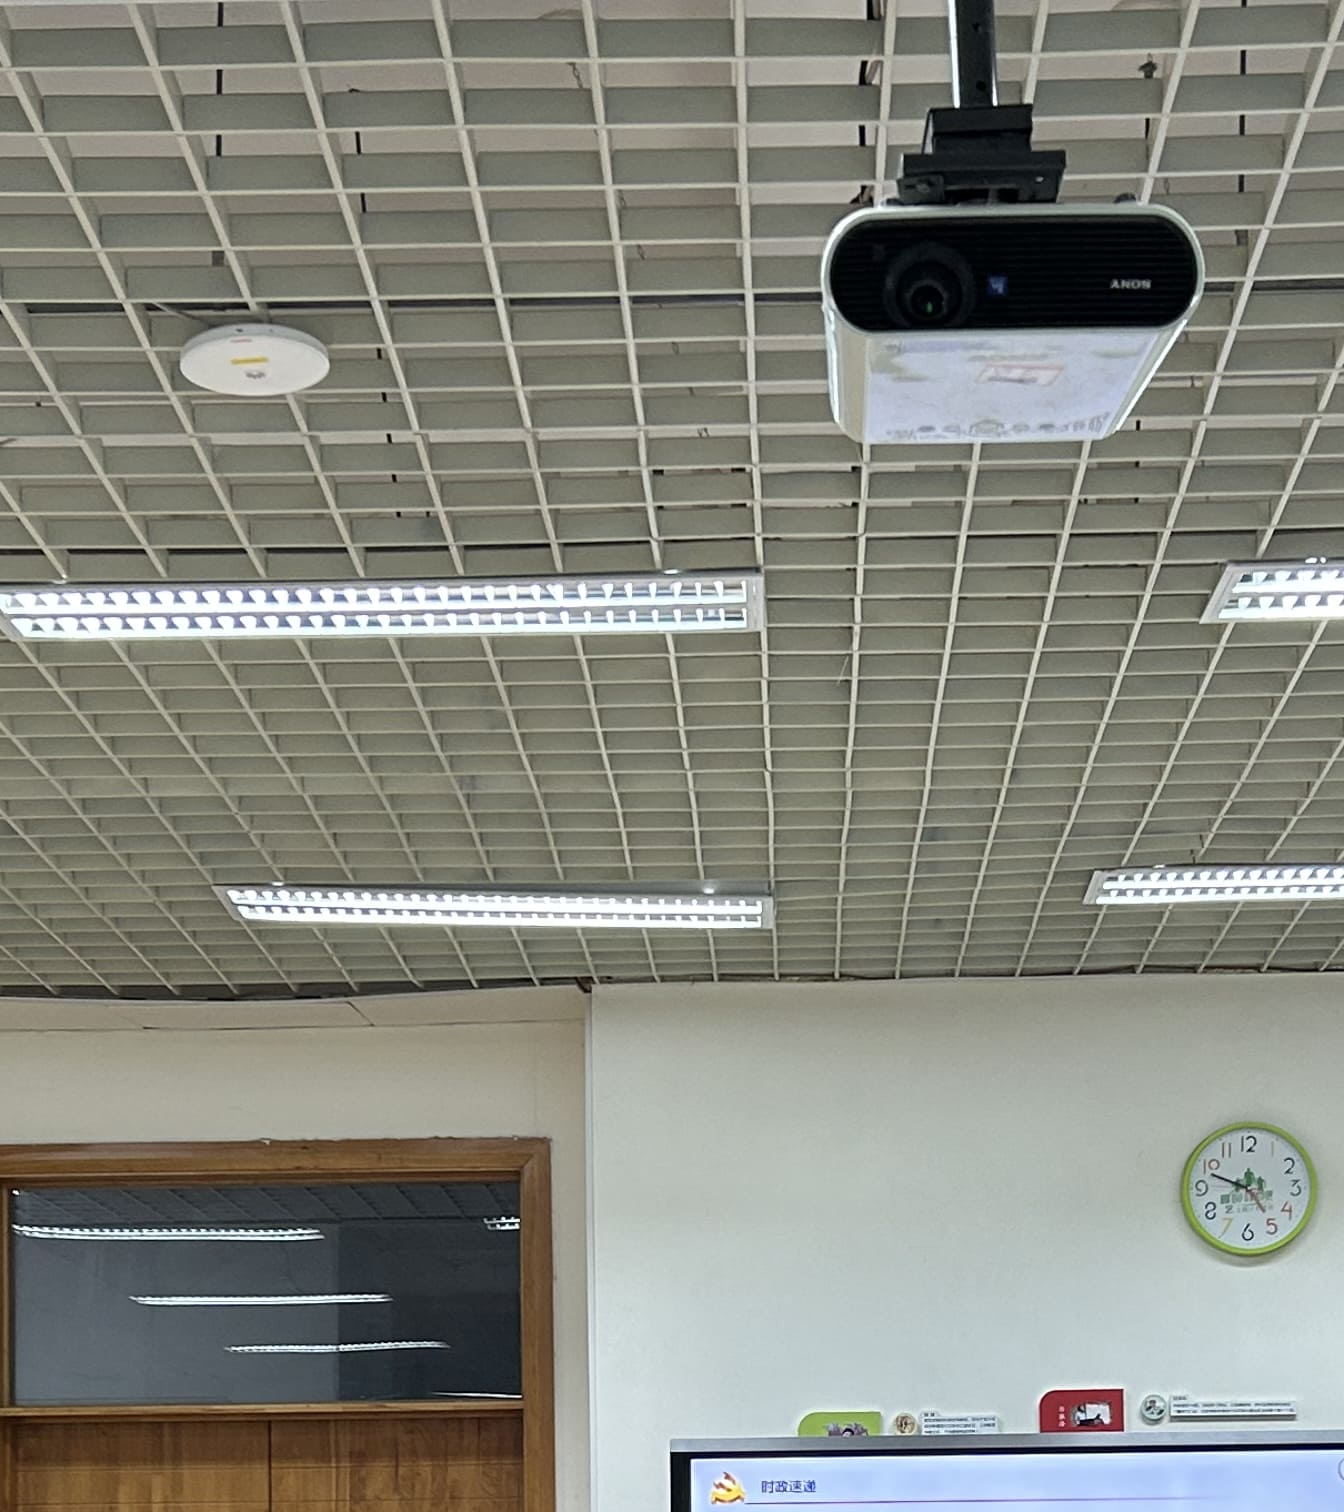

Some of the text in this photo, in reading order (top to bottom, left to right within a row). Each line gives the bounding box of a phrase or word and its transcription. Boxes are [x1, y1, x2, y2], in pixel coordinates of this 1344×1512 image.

[1109, 278, 1152, 290] SONY
[1221, 1142, 1232, 1158] 11
[1240, 1135, 1257, 1153] 12
[1203, 1158, 1220, 1175] 10
[1283, 1157, 1295, 1175] 2
[1195, 1179, 1209, 1197] 9
[1290, 1179, 1302, 1196] 3
[1204, 1201, 1217, 1220] 8
[1281, 1201, 1293, 1221] 4
[1219, 1218, 1233, 1239] 7
[1241, 1223, 1255, 1241] 6
[1266, 1218, 1278, 1235] 5
[761, 1480, 817, 1494] 时政速递
